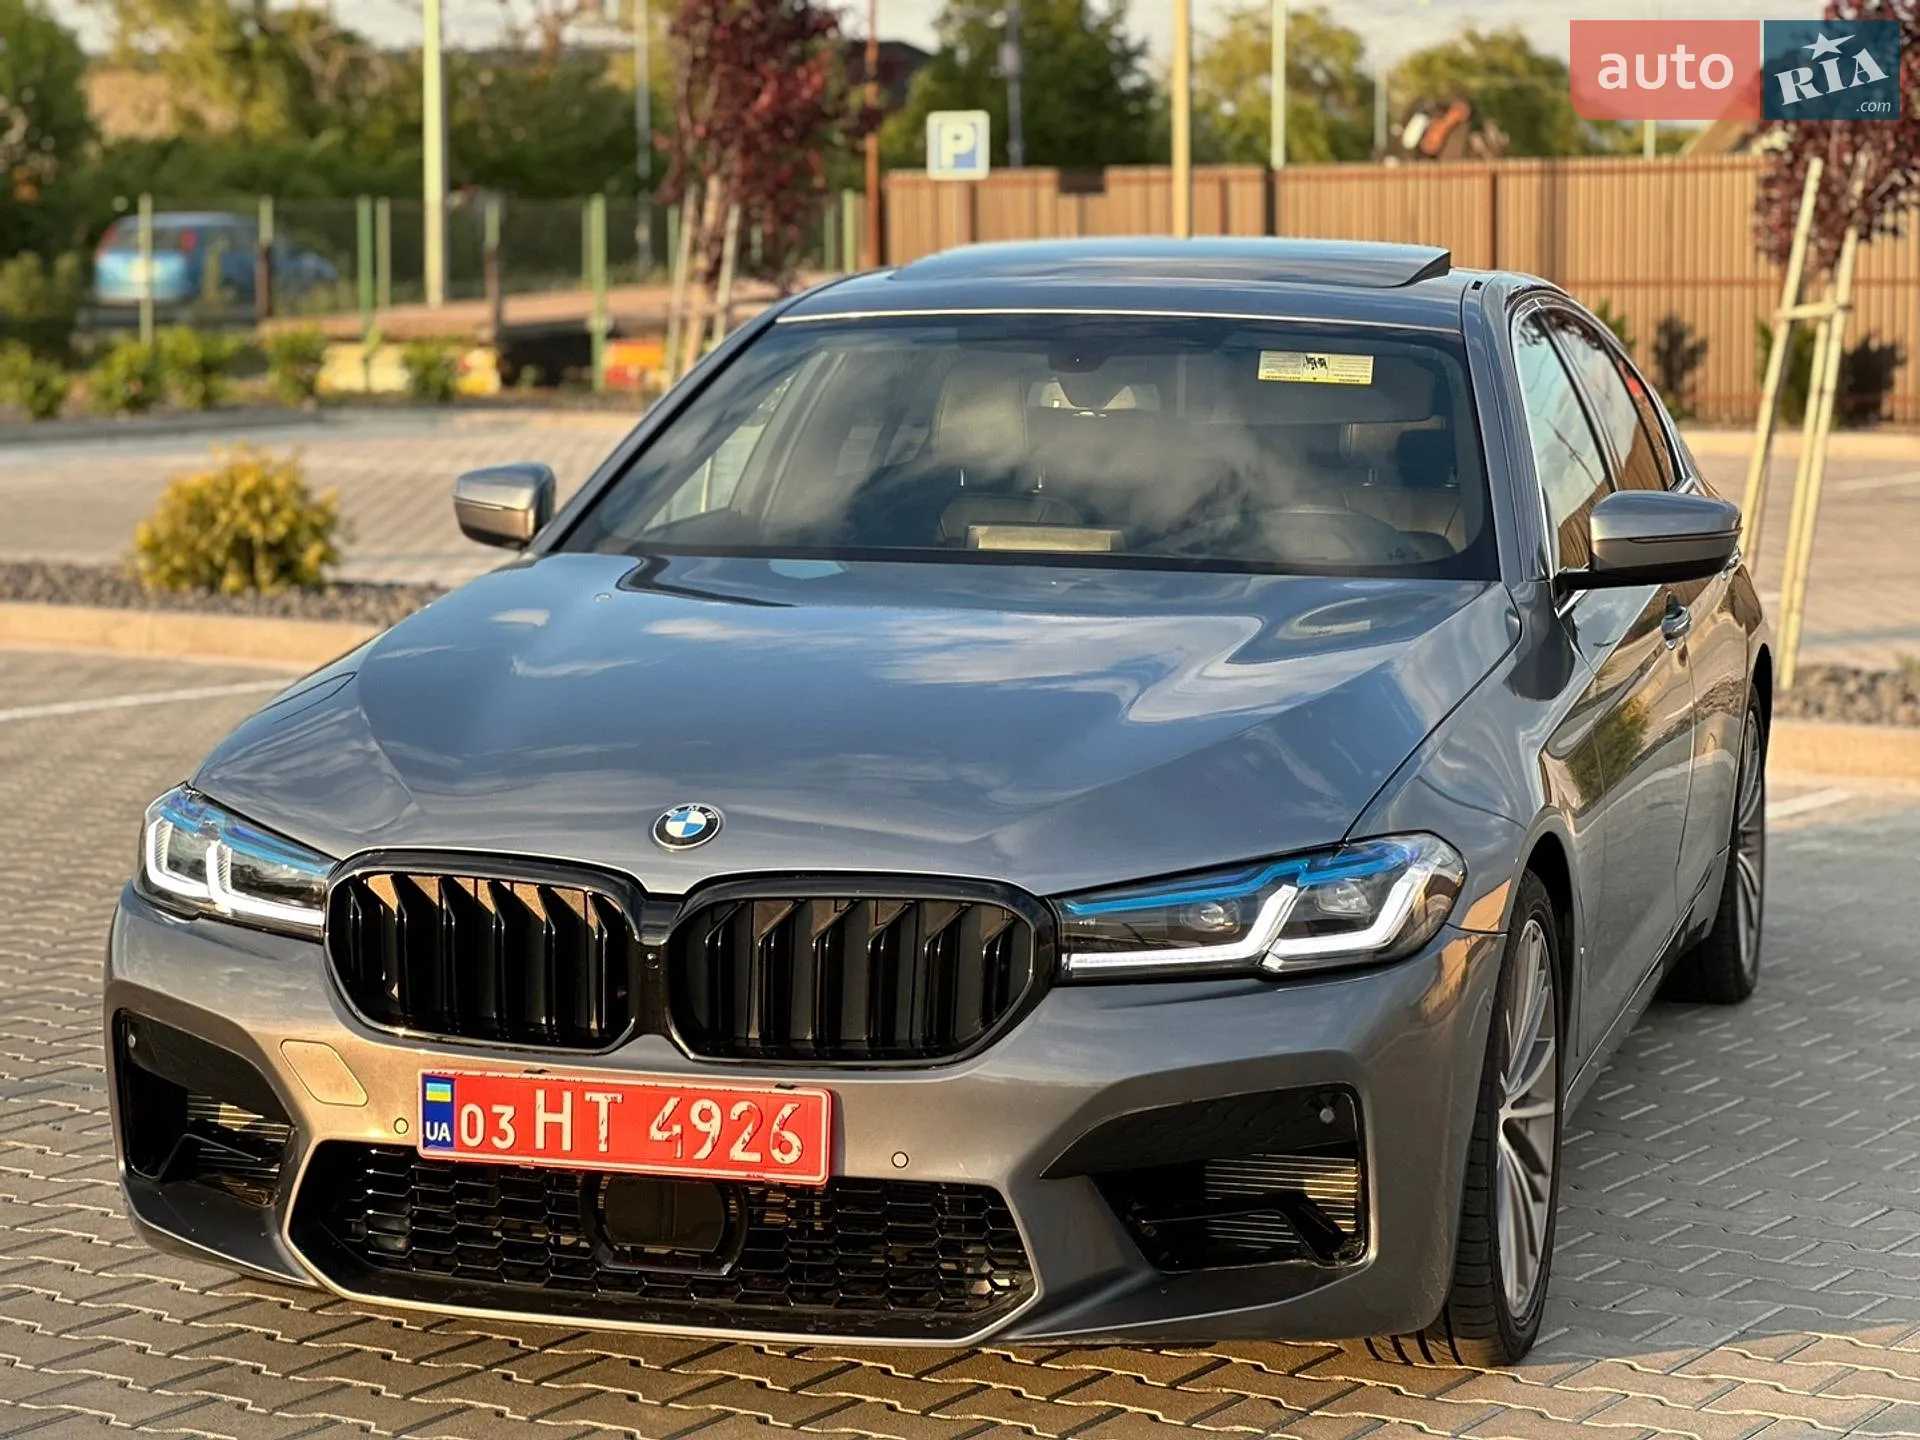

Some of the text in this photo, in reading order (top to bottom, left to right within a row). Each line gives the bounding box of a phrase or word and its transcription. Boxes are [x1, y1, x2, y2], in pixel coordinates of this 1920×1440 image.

[940, 123, 976, 168] P
[426, 1120, 451, 1142] UA
[459, 1089, 803, 1165] 03 HT 4926
